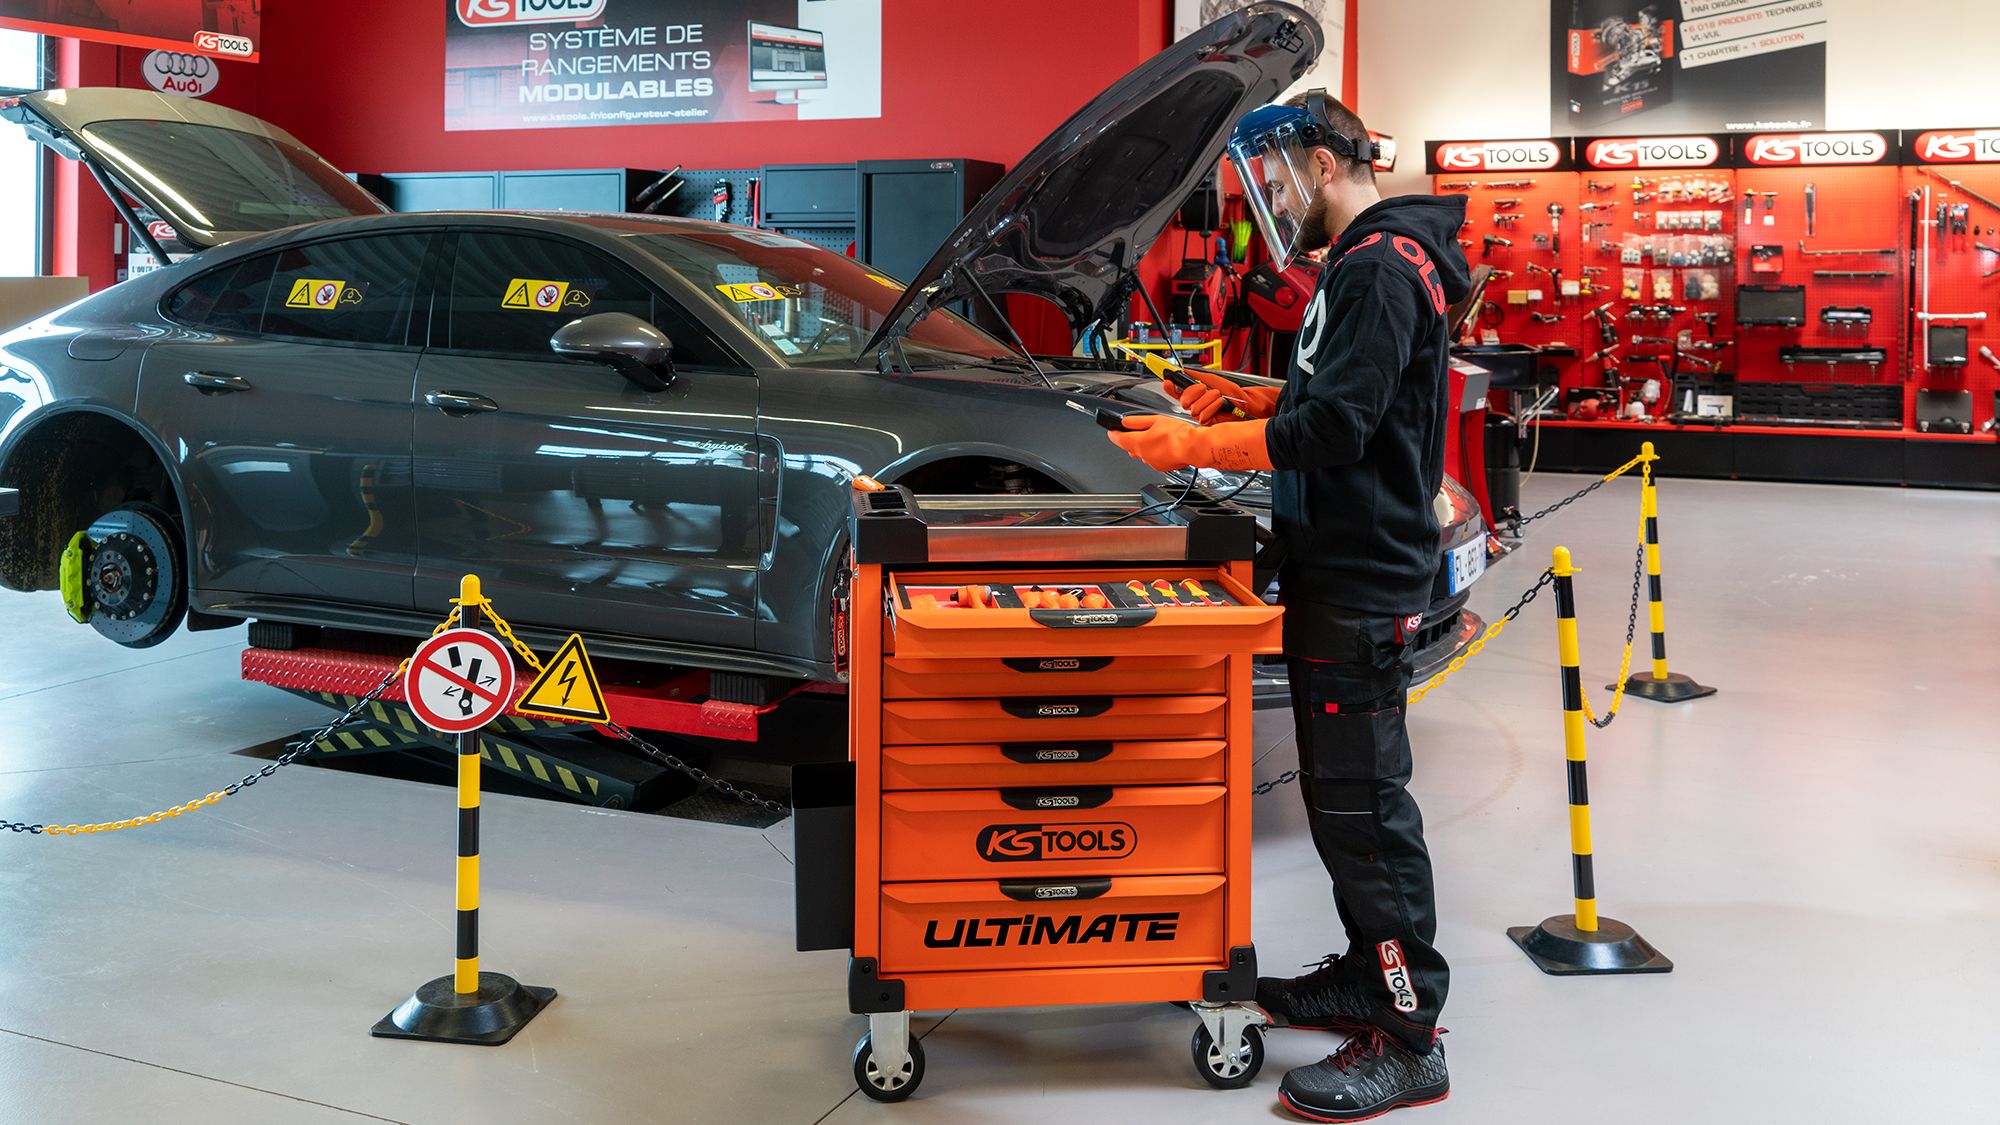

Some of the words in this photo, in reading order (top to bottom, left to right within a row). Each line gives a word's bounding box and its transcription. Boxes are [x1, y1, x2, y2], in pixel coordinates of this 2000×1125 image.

[1718, 11, 1764, 27] PRODUITS
[1765, 0, 1823, 17] TECHNIQUES
[197, 34, 218, 49] KS
[218, 38, 248, 52] TOOLS
[529, 24, 656, 51] SYSTÈME
[666, 24, 703, 45] DE
[1697, 45, 1740, 60] CHAPITRE
[1759, 32, 1805, 47] SOLUTION
[521, 50, 711, 77] RANGEMENTS
[162, 76, 202, 93] Audi
[519, 77, 714, 103] MODULABLES
[523, 108, 708, 122] www.kstools.fr/configurateur-atelier
[1443, 146, 1485, 167] KS
[1486, 148, 1549, 163] TOOLS
[1594, 143, 1639, 165] KS
[1640, 144, 1707, 160] TOOLS
[1753, 139, 1801, 161] KS
[1802, 140, 1874, 156] TOOLS
[1925, 135, 1976, 158] KS
[1090, 615, 1116, 623] TOOLS
[1054, 660, 1077, 668] TOOLS
[1054, 706, 1076, 714] TOOLS
[1054, 751, 1076, 759] TOOLS
[1053, 797, 1076, 805] TOOLS
[986, 829, 1042, 857] KS
[1042, 829, 1126, 852] TOOLS
[1052, 887, 1075, 896] TOOLS
